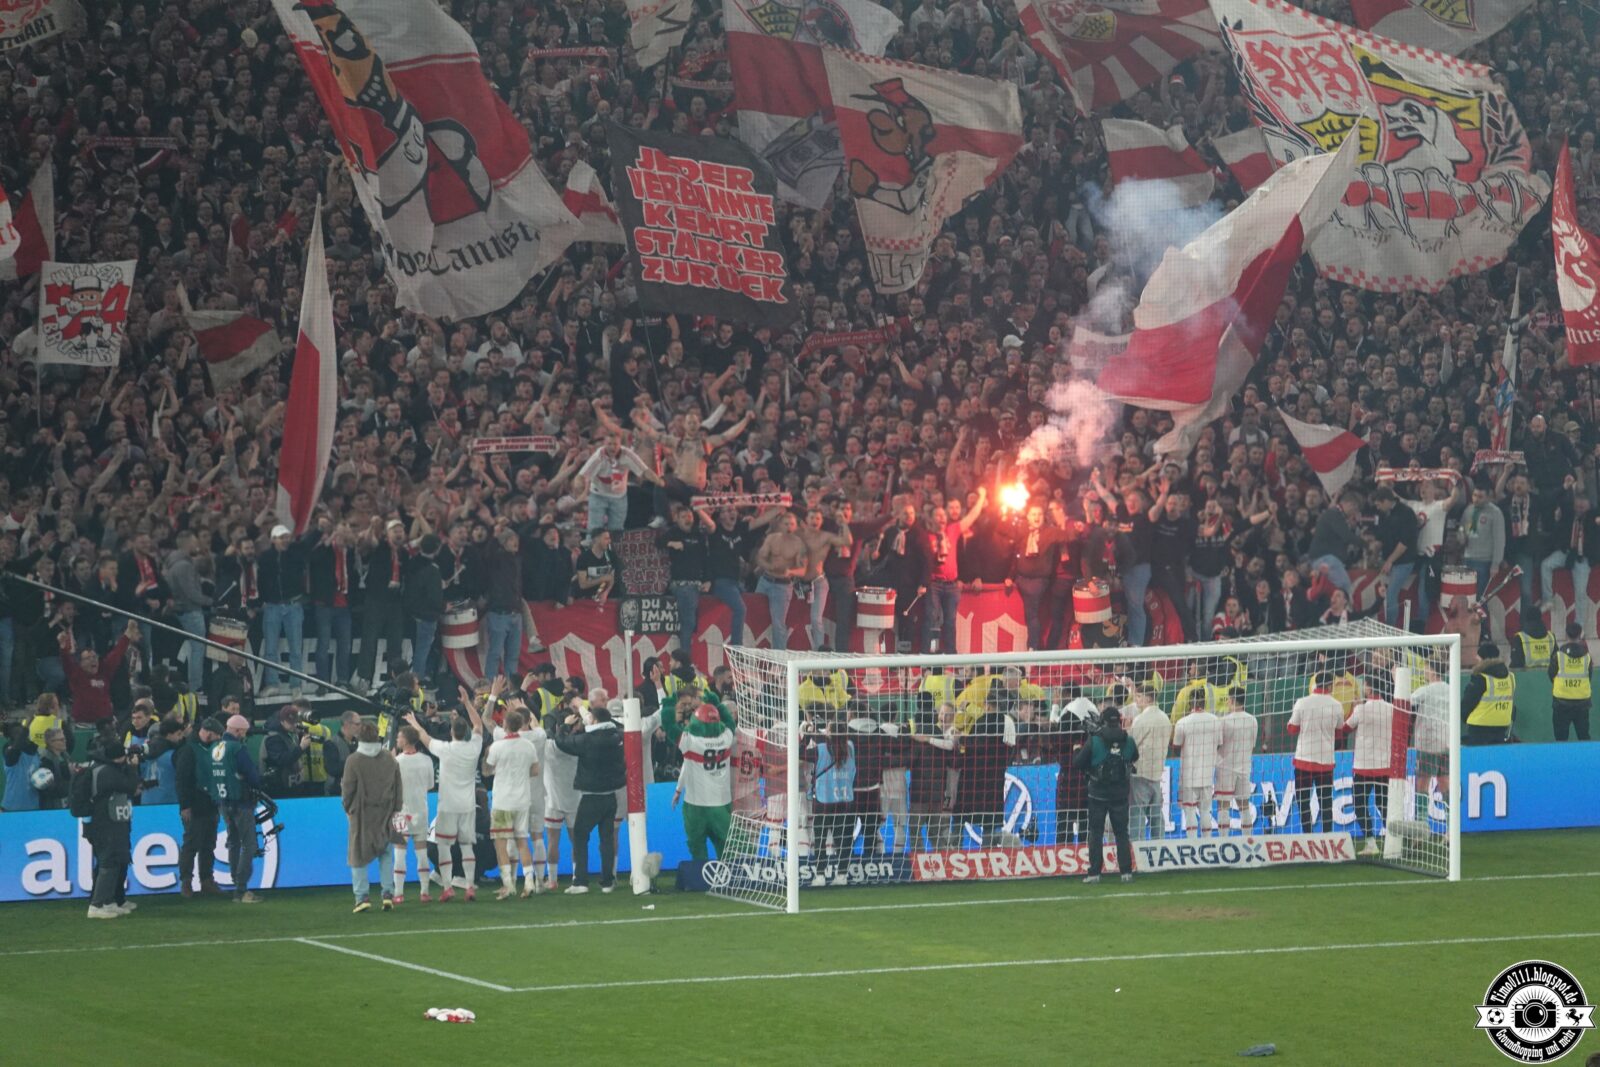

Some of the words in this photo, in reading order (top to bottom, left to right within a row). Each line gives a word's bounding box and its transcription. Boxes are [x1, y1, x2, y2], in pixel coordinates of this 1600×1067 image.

[635, 145, 755, 193] JEDER
[626, 166, 776, 225] VERBANNTE
[643, 201, 768, 248] KEHRT
[641, 599, 660, 609] DU
[1564, 679, 1583, 688] 1827
